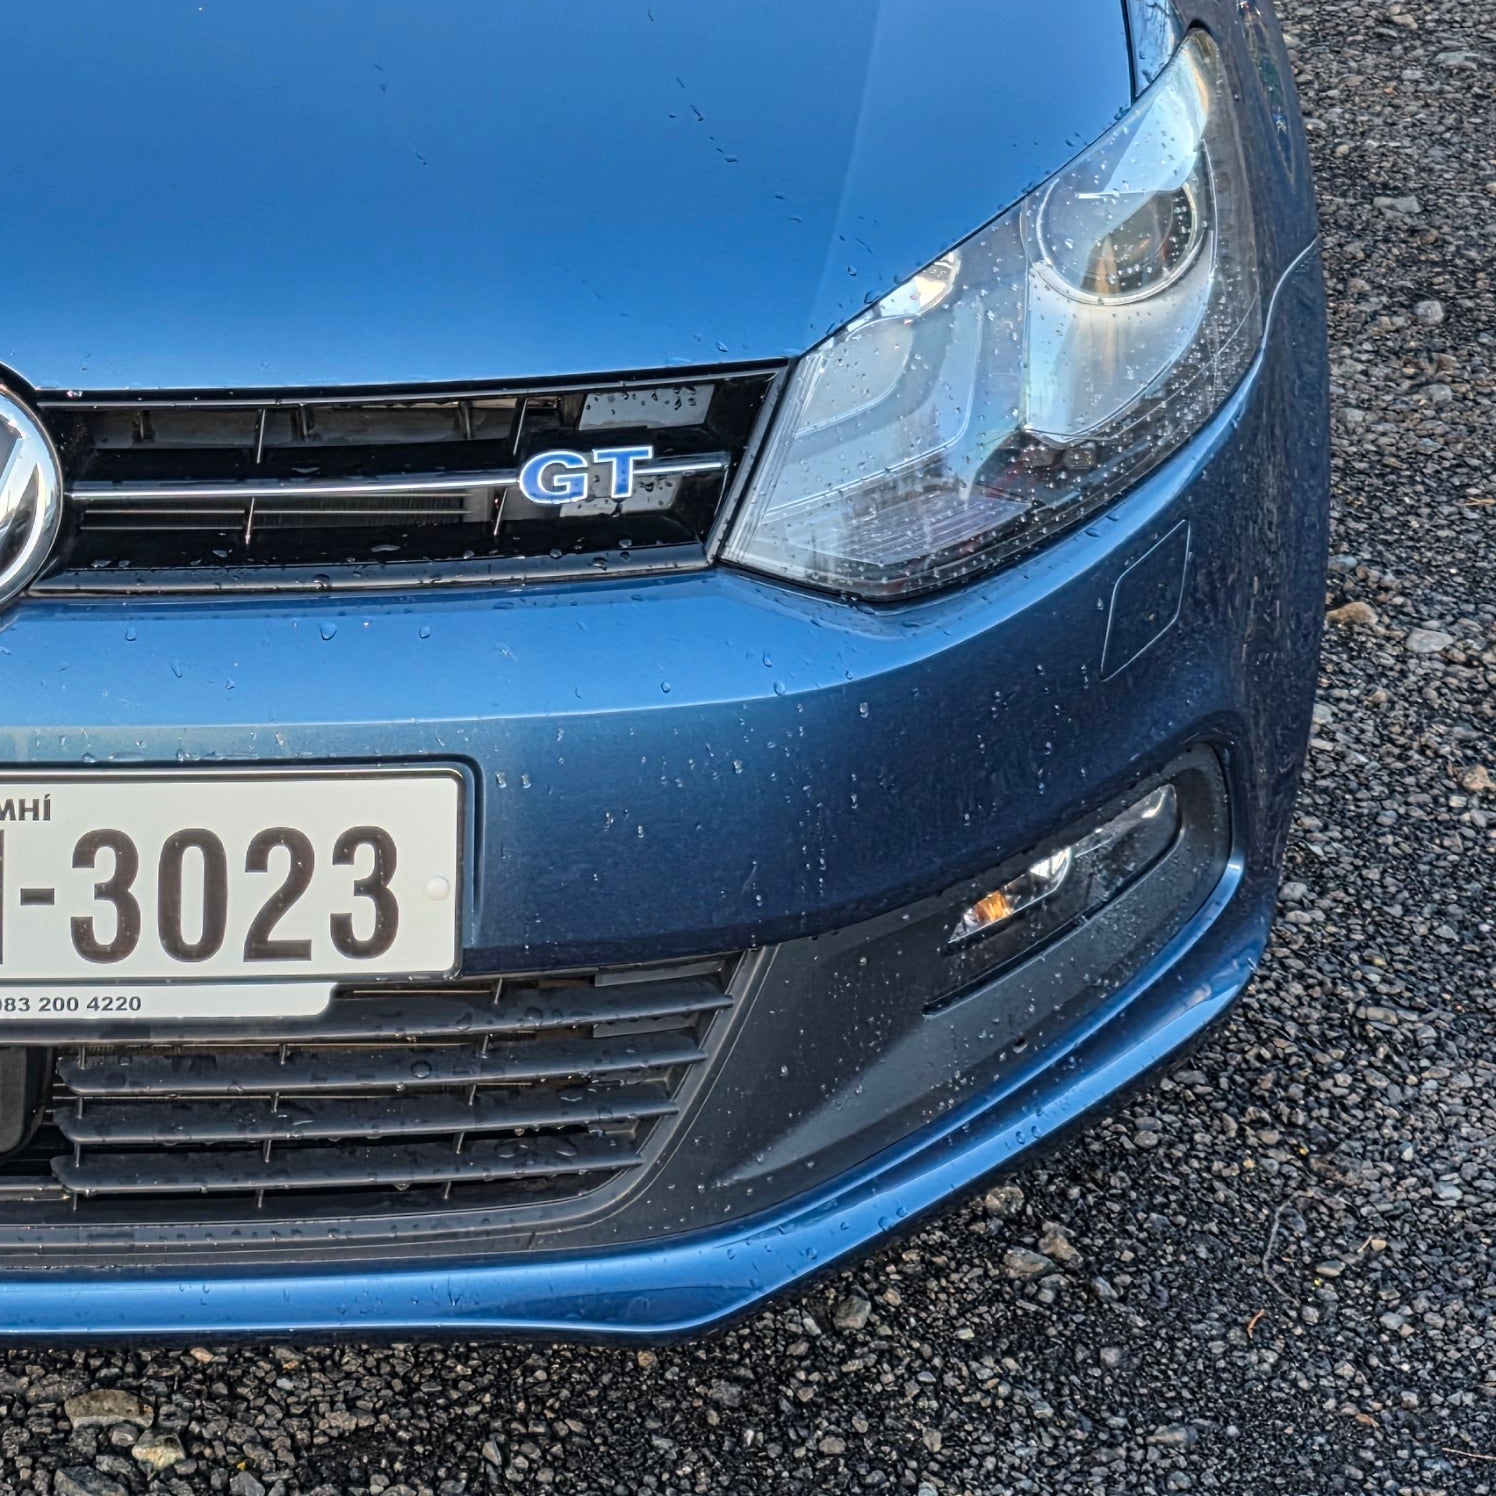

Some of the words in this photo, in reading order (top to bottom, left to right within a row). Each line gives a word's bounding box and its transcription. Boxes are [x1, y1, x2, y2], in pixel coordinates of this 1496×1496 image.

[518, 444, 654, 505] GT
[37, 996, 80, 1013] 200
[85, 995, 143, 1013] 4220
